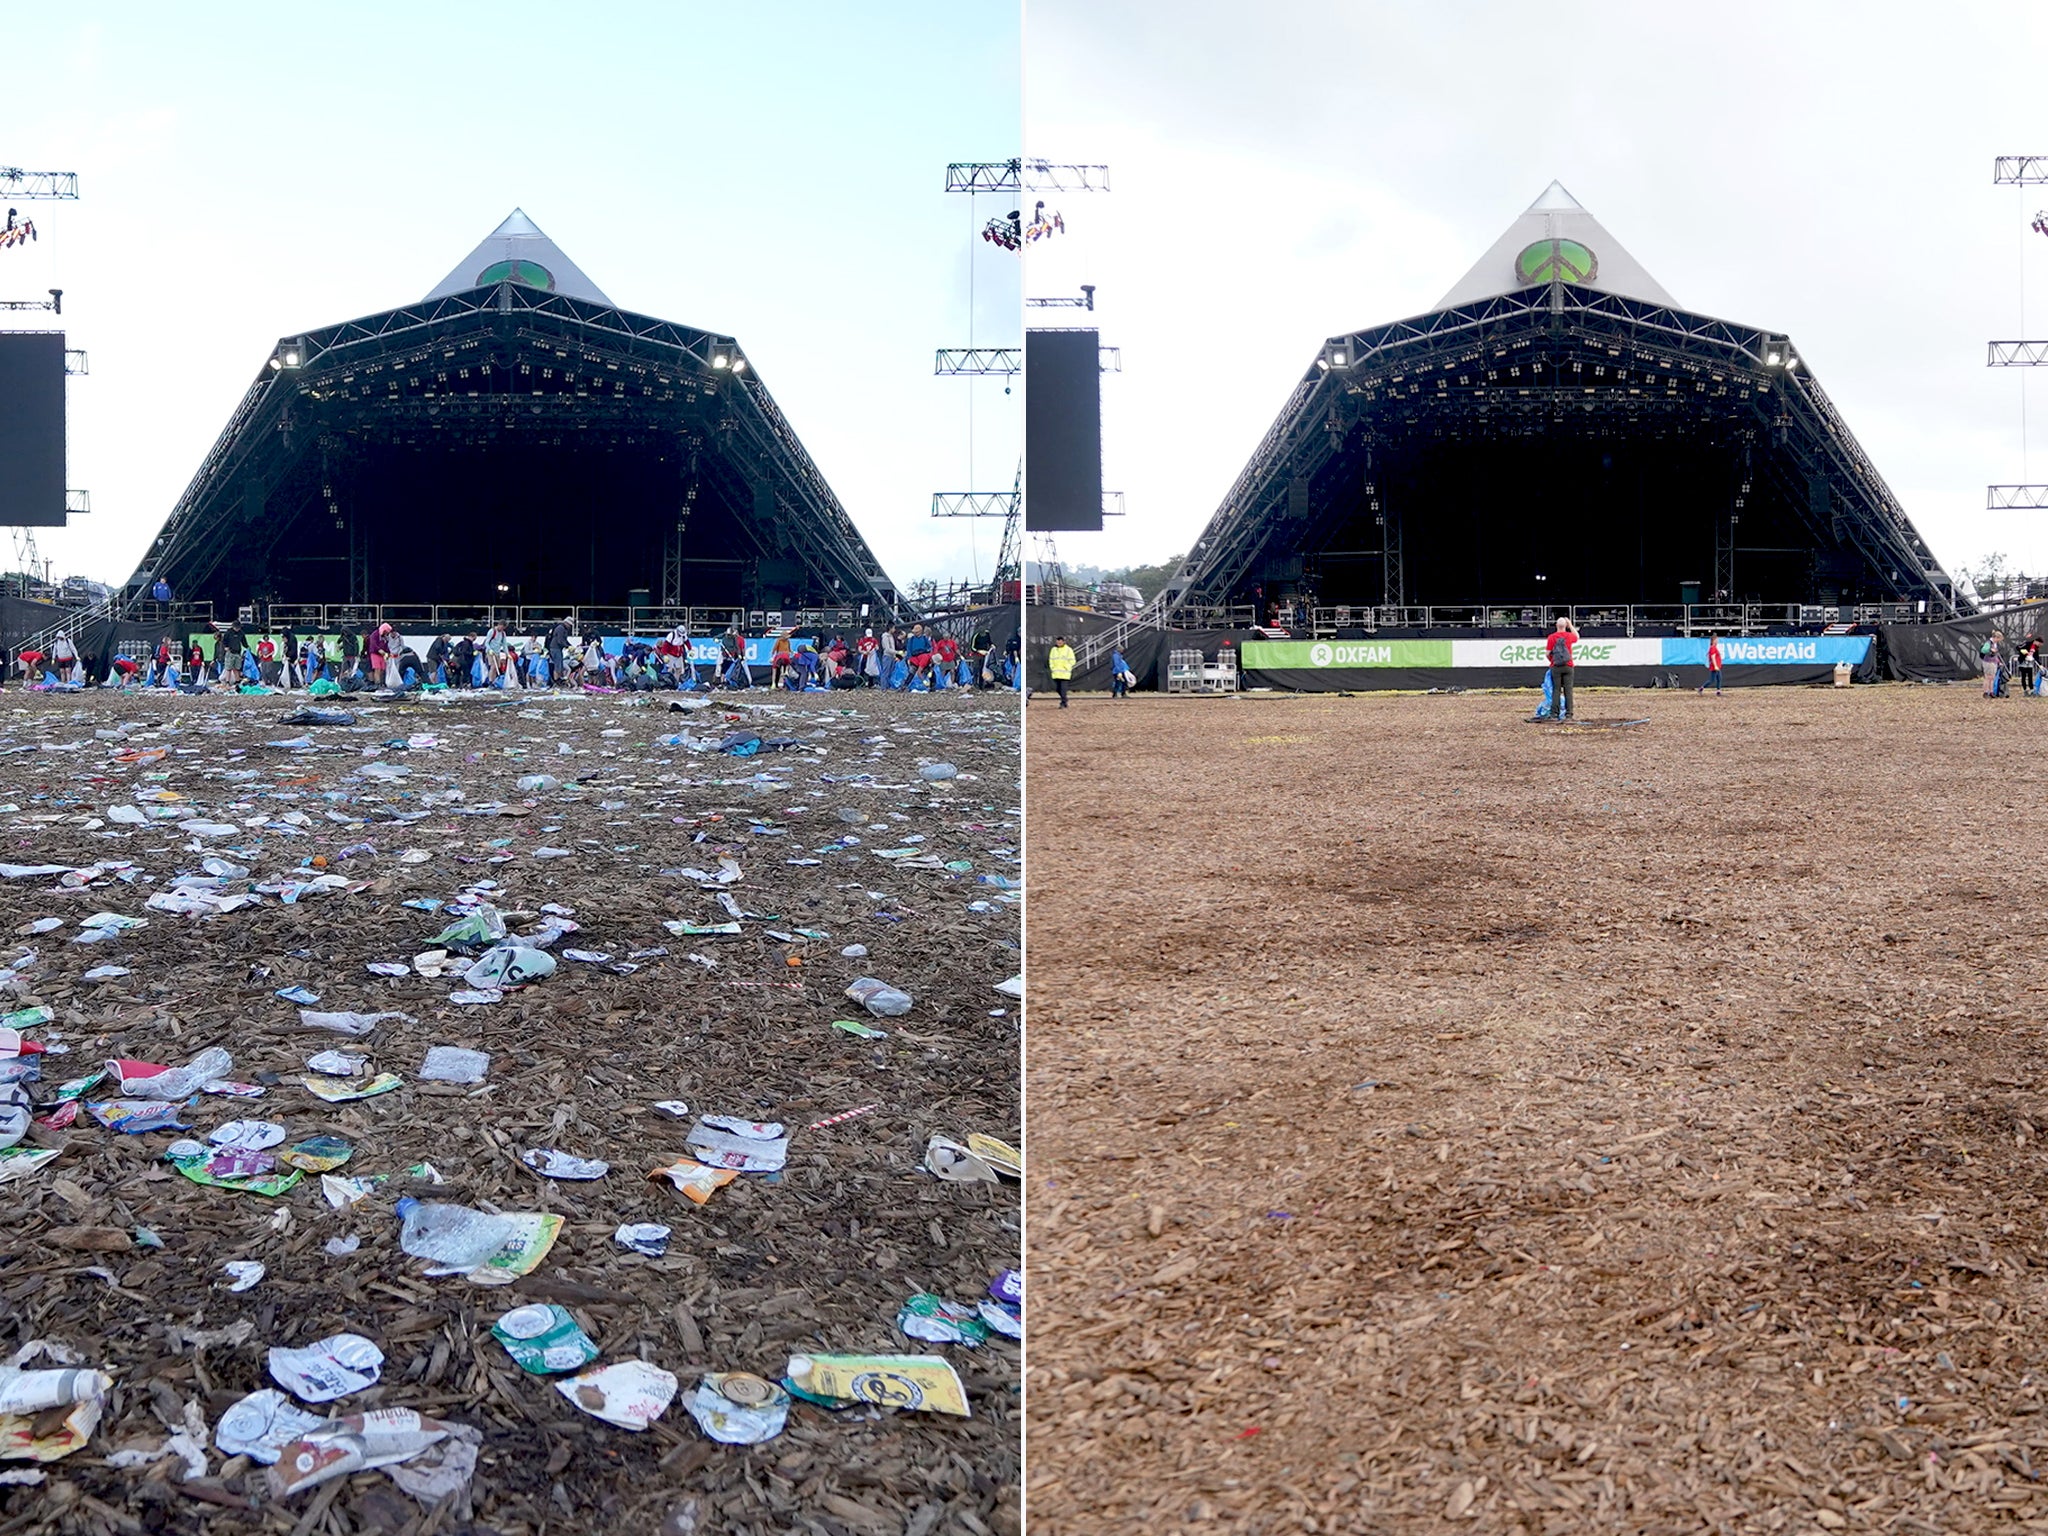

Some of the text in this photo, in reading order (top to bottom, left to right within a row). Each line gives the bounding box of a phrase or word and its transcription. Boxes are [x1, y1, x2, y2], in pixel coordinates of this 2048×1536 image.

[1335, 646, 1392, 663] OXFAM
[1499, 644, 1616, 664] GREEEACE
[1727, 642, 1816, 660] WaterAid
